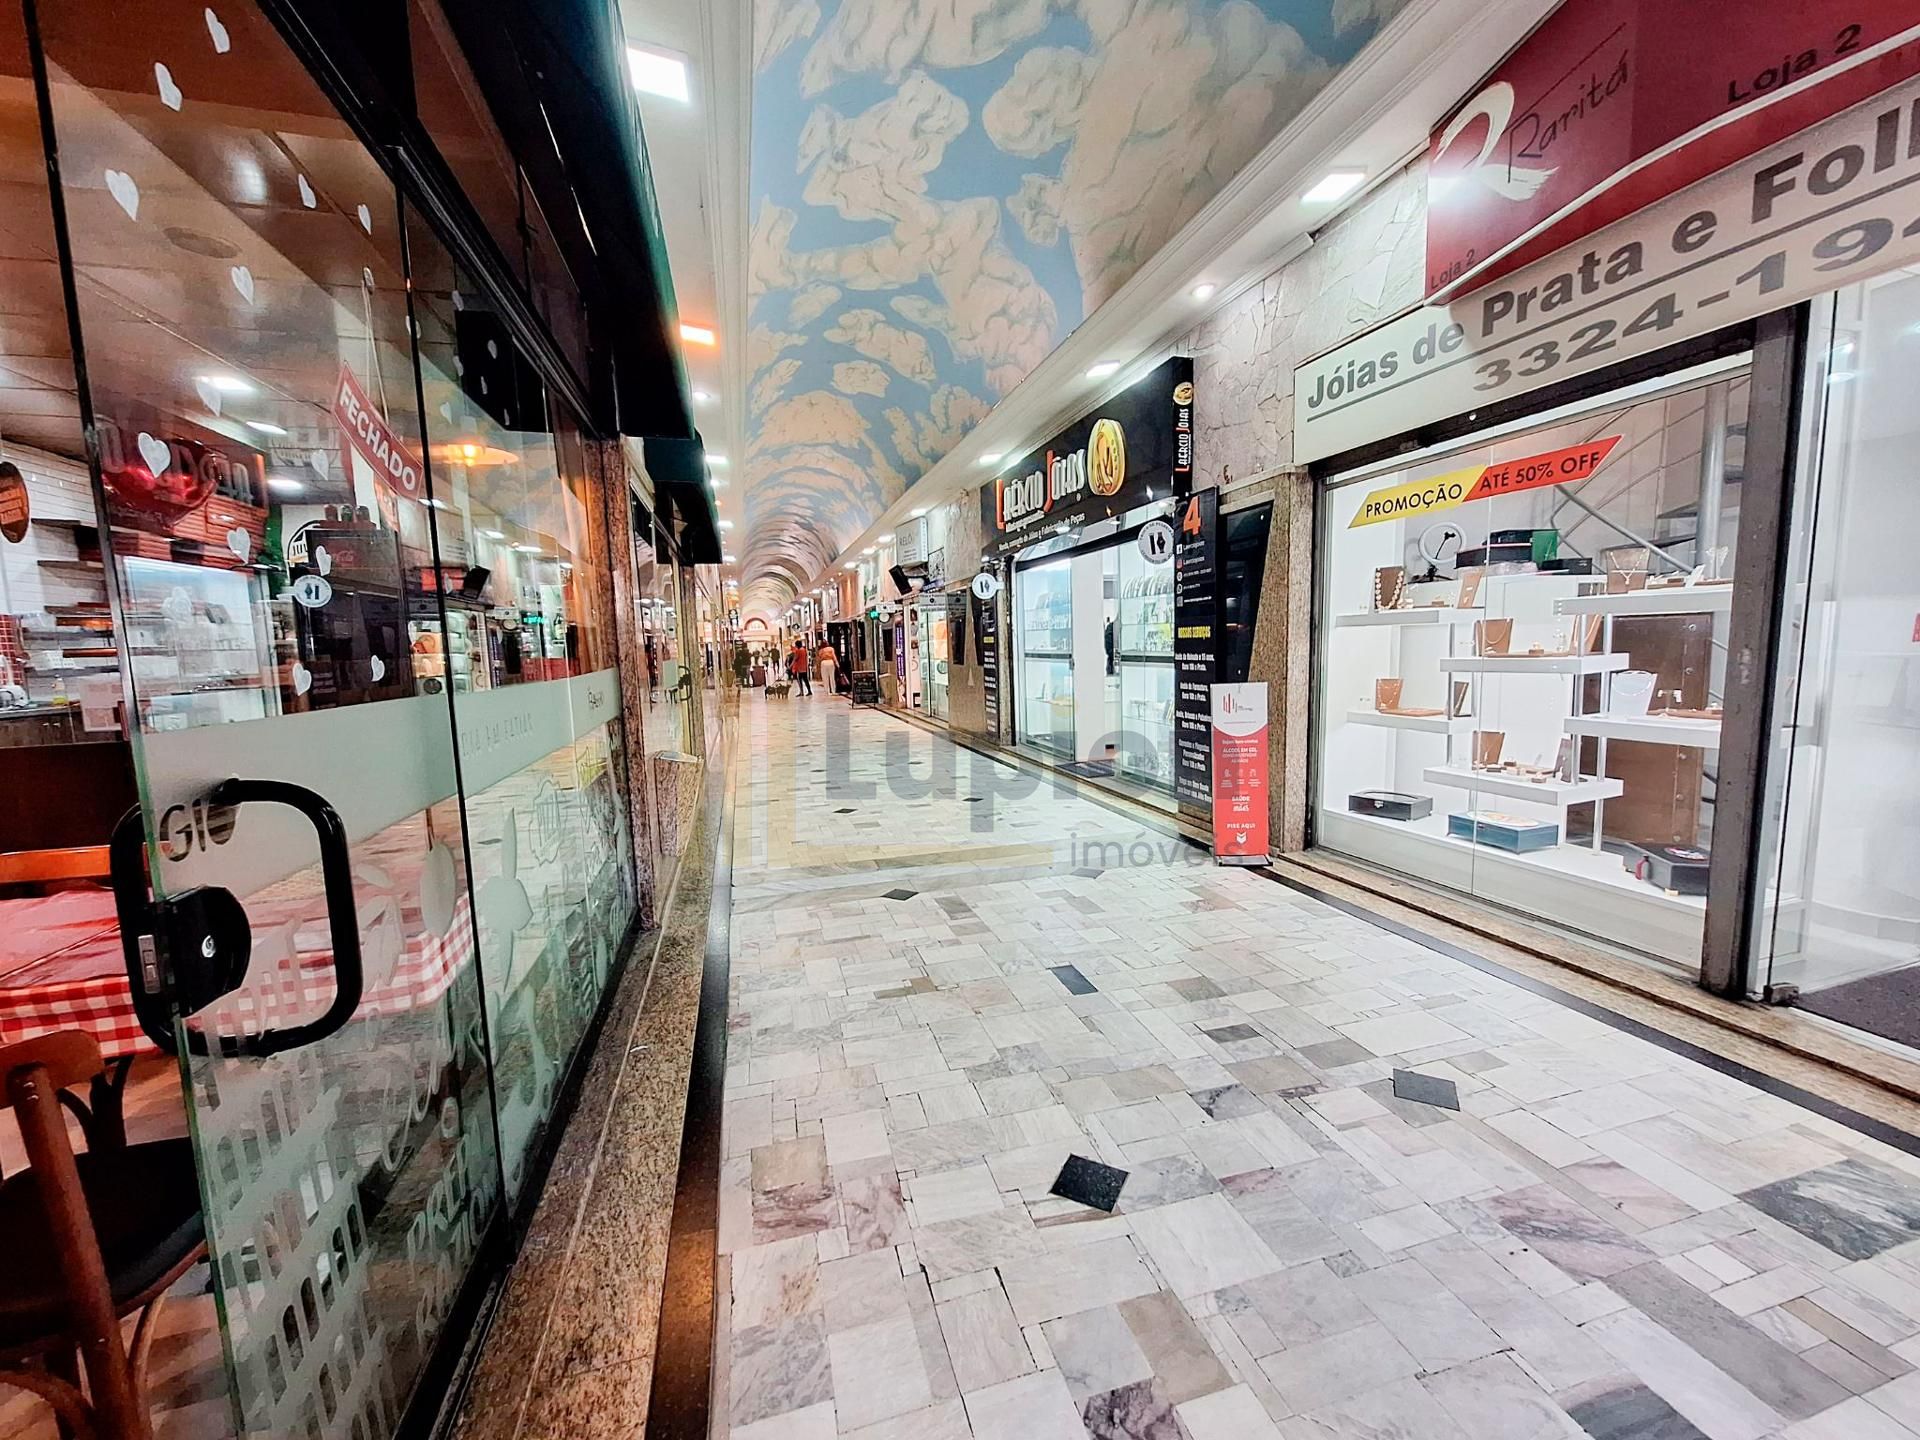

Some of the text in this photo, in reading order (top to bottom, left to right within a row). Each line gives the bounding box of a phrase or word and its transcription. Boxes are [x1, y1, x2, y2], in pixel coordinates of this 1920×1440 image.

[1727, 24, 1862, 104] Loja 2
[1307, 97, 1920, 409] Jóias de Prata e Fol
[1431, 248, 1475, 288] Loja 2
[1472, 217, 1920, 391] 3324-19
[339, 383, 417, 491] FECHADO
[1183, 496, 1202, 535] 4
[1366, 451, 1600, 518] PROMOÇÃO ATÉ 50% OFF
